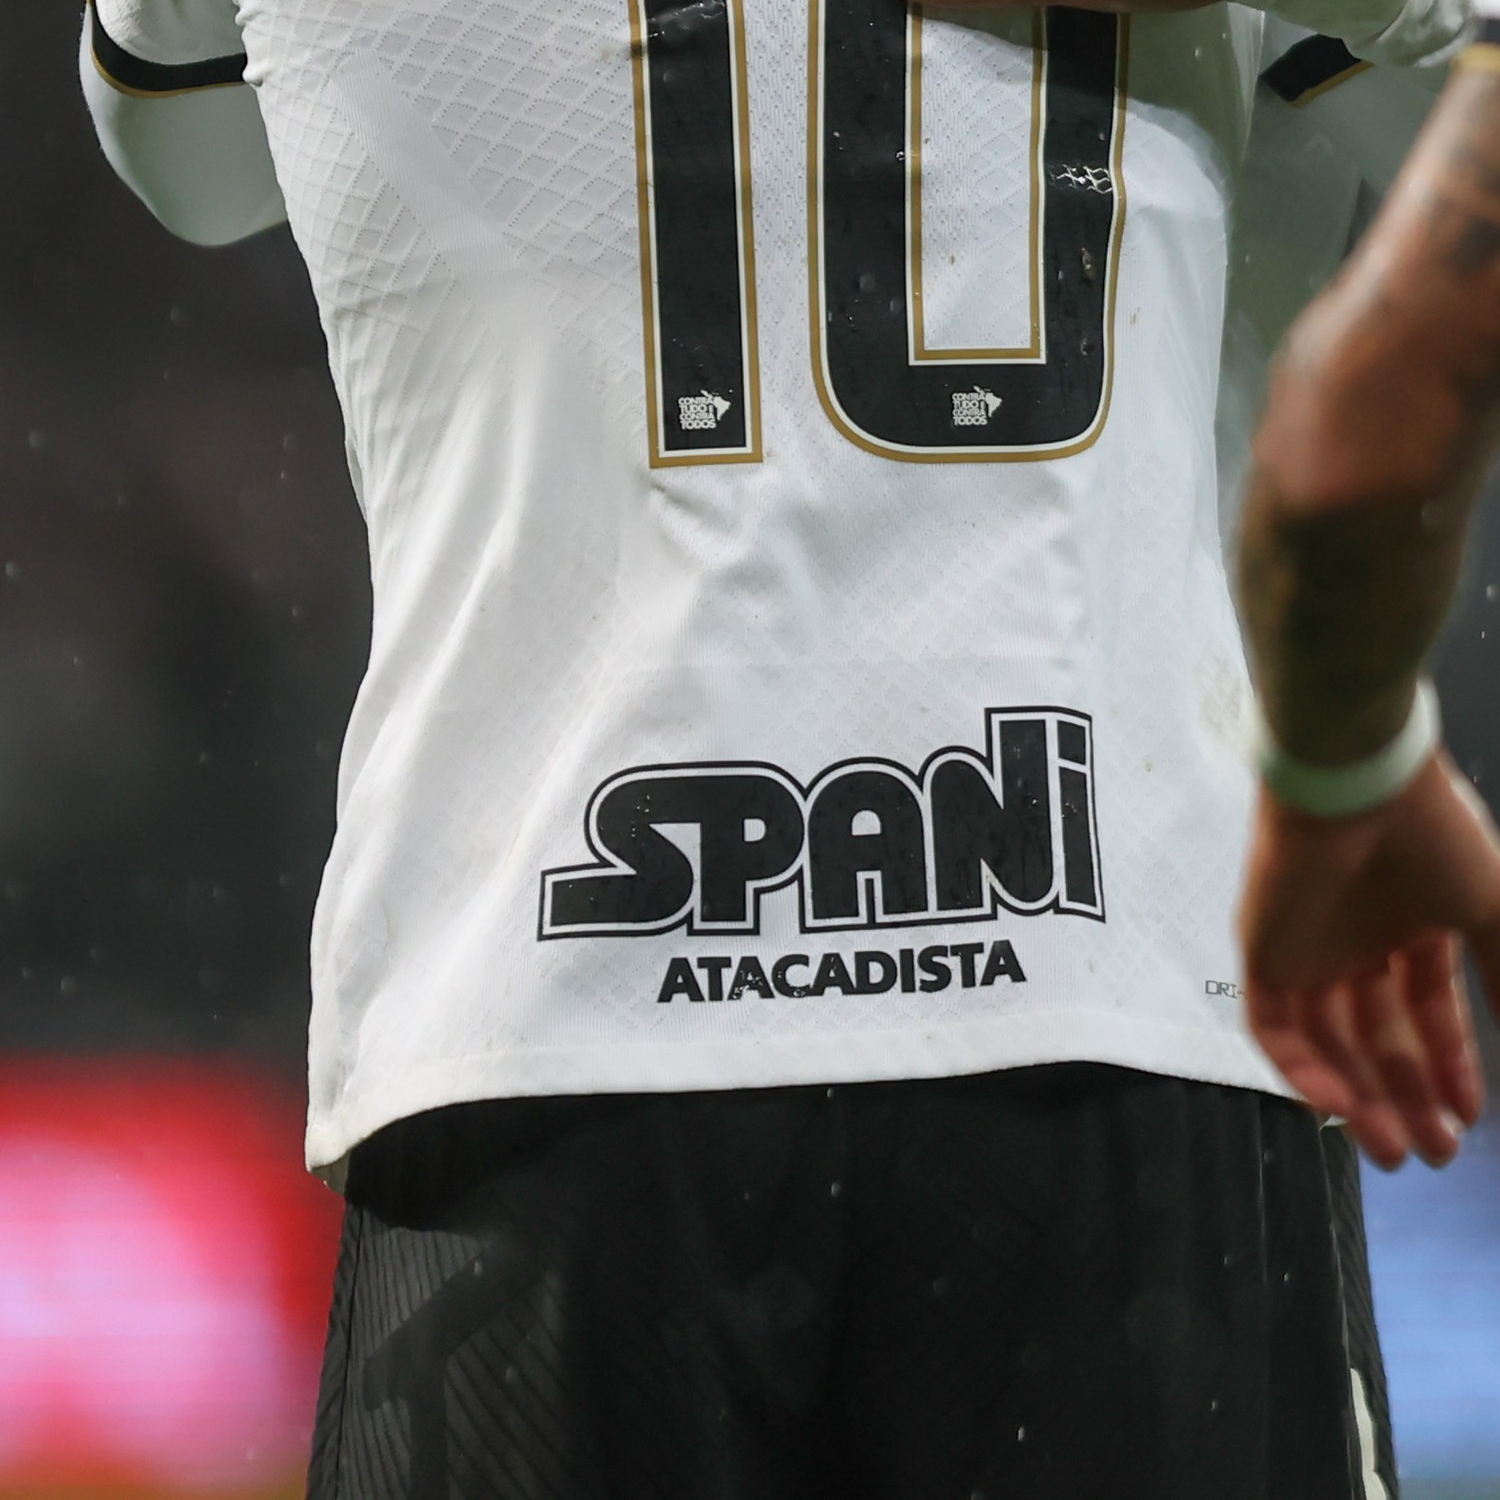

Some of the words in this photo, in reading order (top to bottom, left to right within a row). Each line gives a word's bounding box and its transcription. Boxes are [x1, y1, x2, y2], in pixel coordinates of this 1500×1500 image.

[680, 420, 716, 430] TODOS
[953, 416, 988, 426] TODOS
[657, 940, 1027, 1003] ATACADISTA
[1205, 980, 1247, 1000] DRI-
